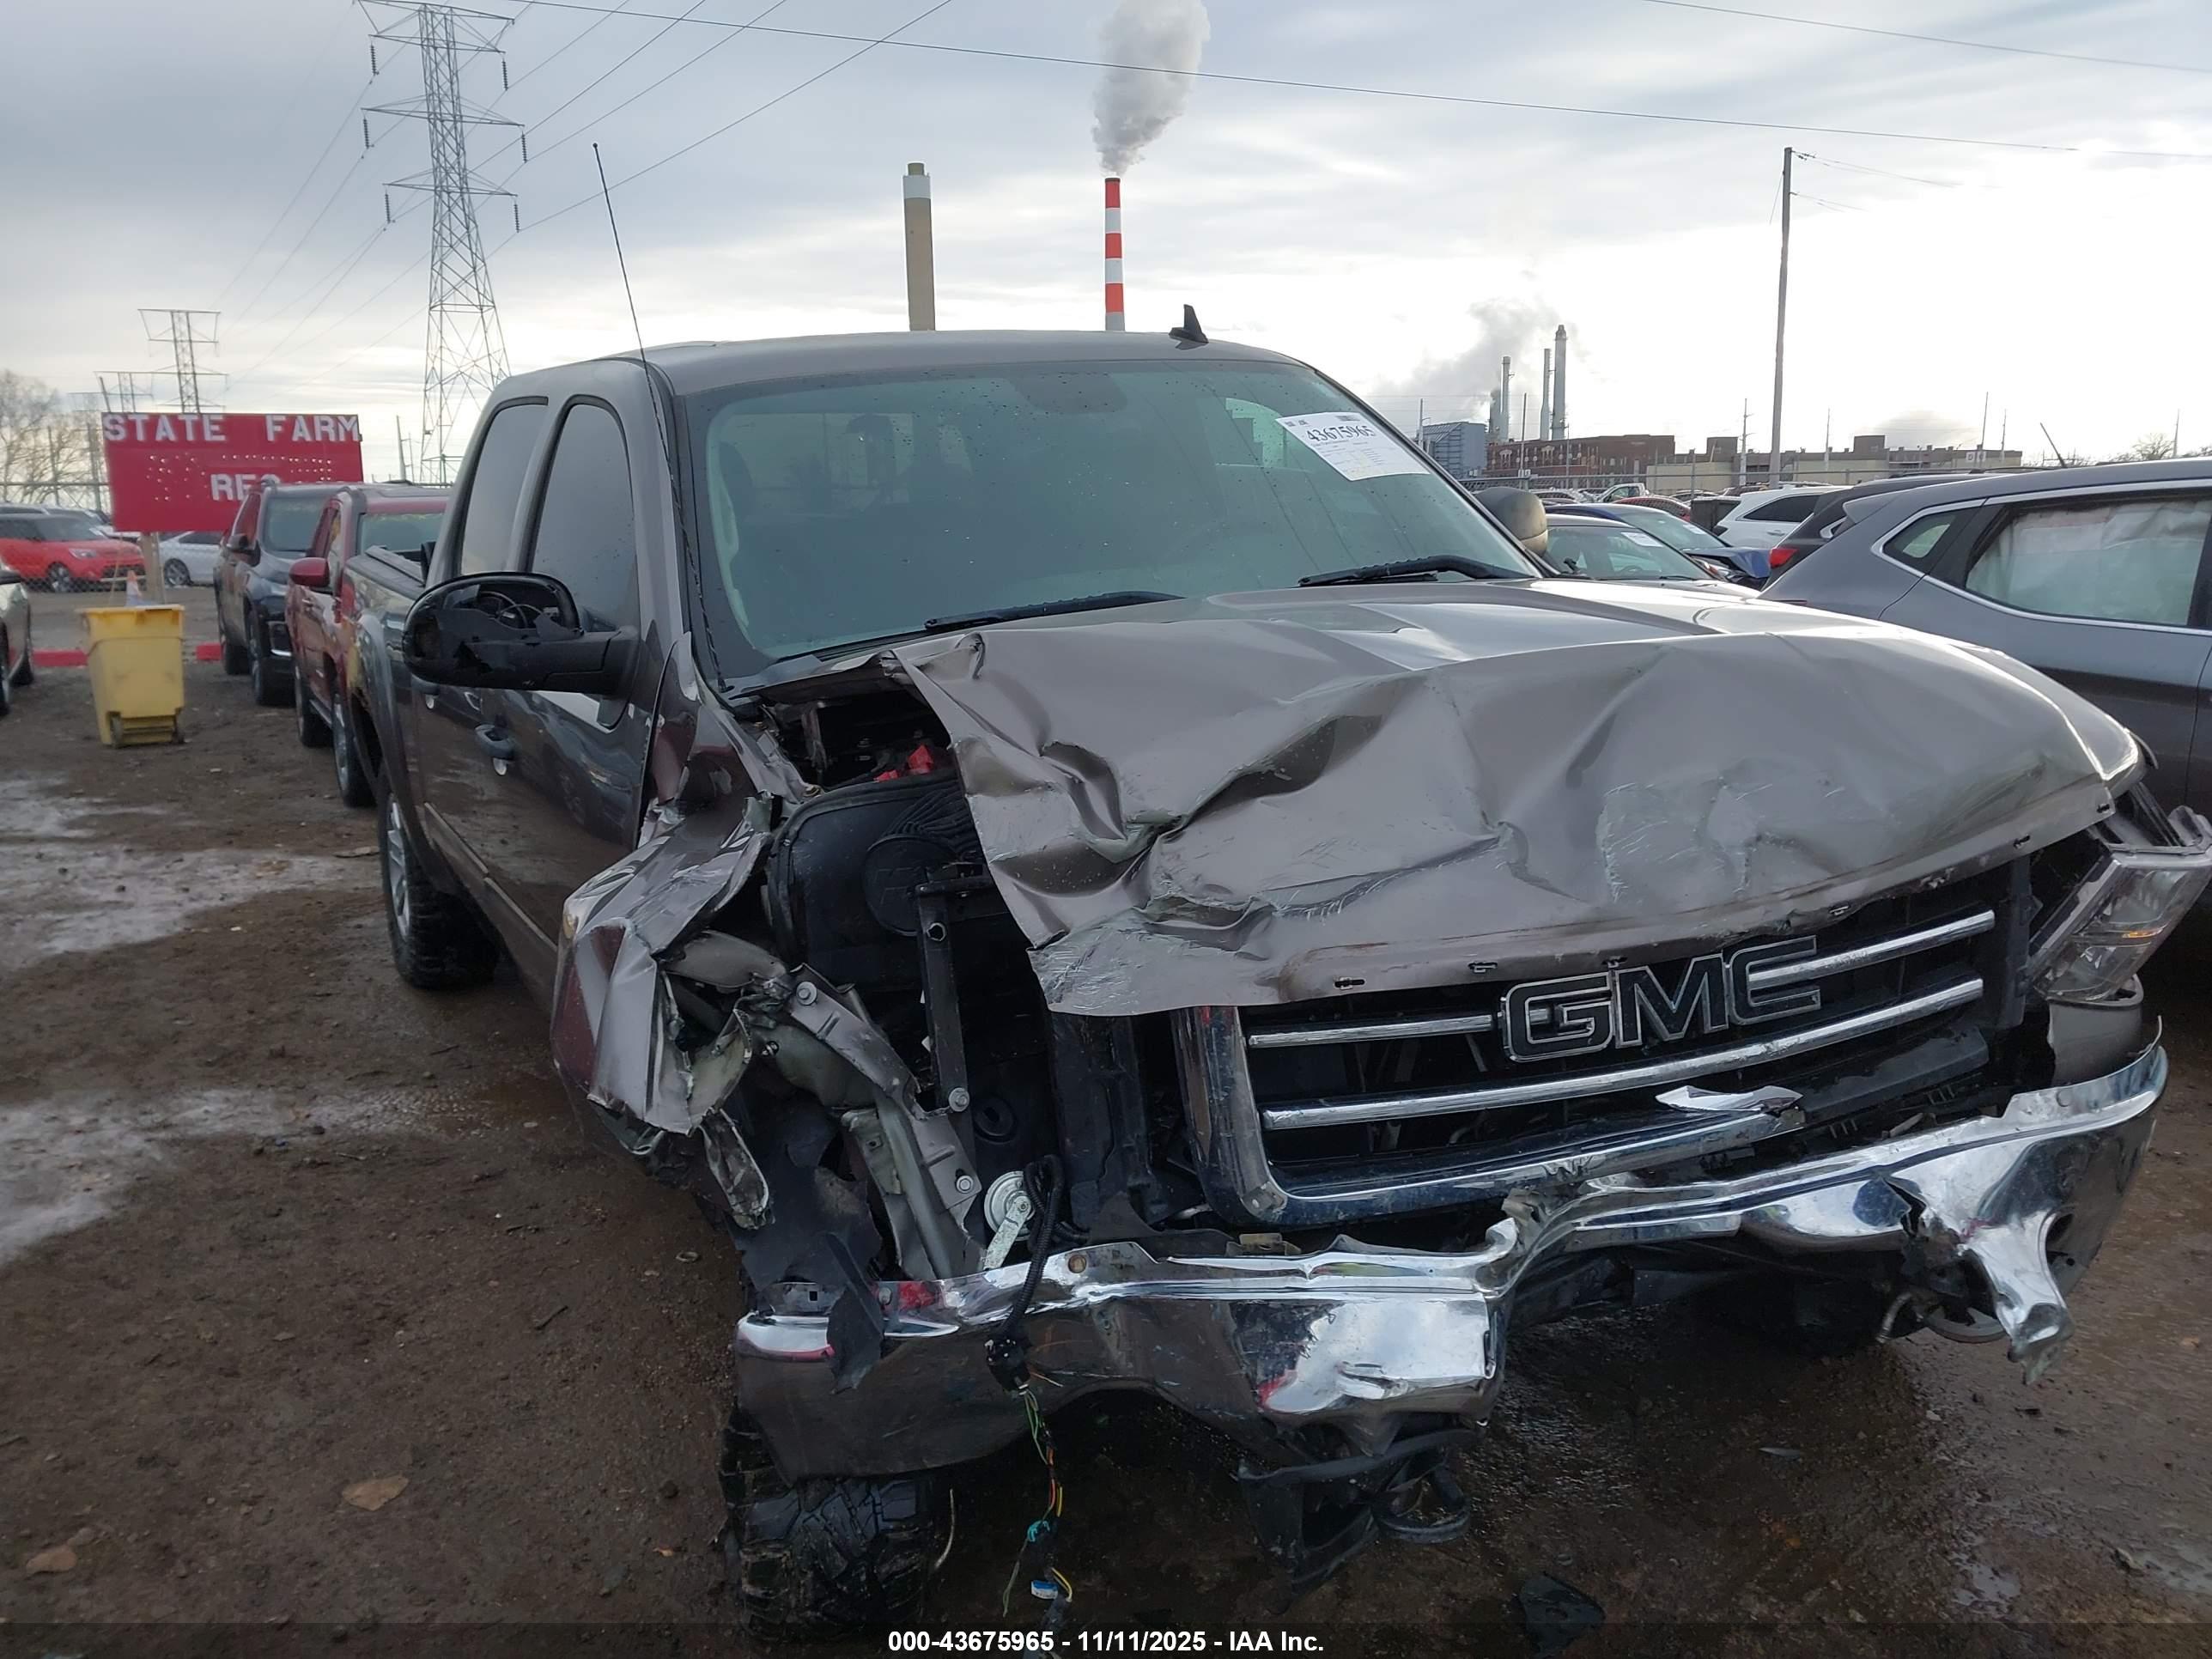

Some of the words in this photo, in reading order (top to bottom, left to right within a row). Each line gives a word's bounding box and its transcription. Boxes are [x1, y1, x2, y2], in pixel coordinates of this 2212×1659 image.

[103, 414, 227, 442] STATE
[265, 415, 360, 442] FARM
[1306, 425, 1376, 441] 43675965
[1501, 935, 1821, 1063] GMC
